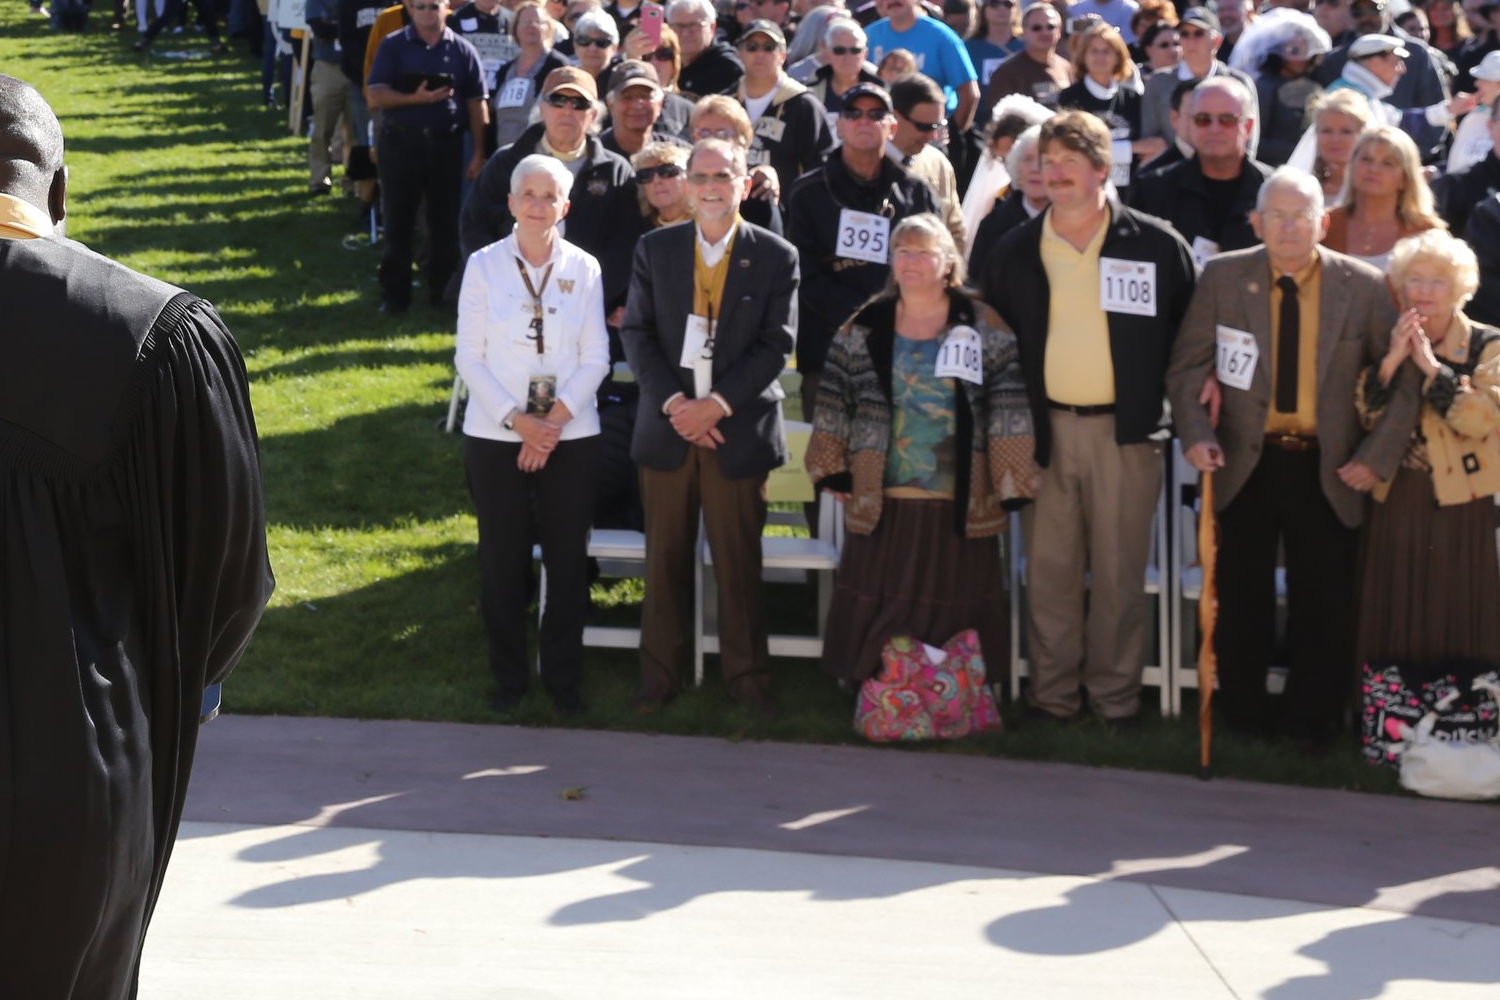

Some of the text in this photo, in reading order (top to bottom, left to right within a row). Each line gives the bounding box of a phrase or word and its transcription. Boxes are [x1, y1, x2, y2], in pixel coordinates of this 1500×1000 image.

[842, 227, 885, 252] 395
[1106, 275, 1152, 304] 1108
[943, 344, 980, 372] 1108
[1221, 347, 1252, 376] 167
